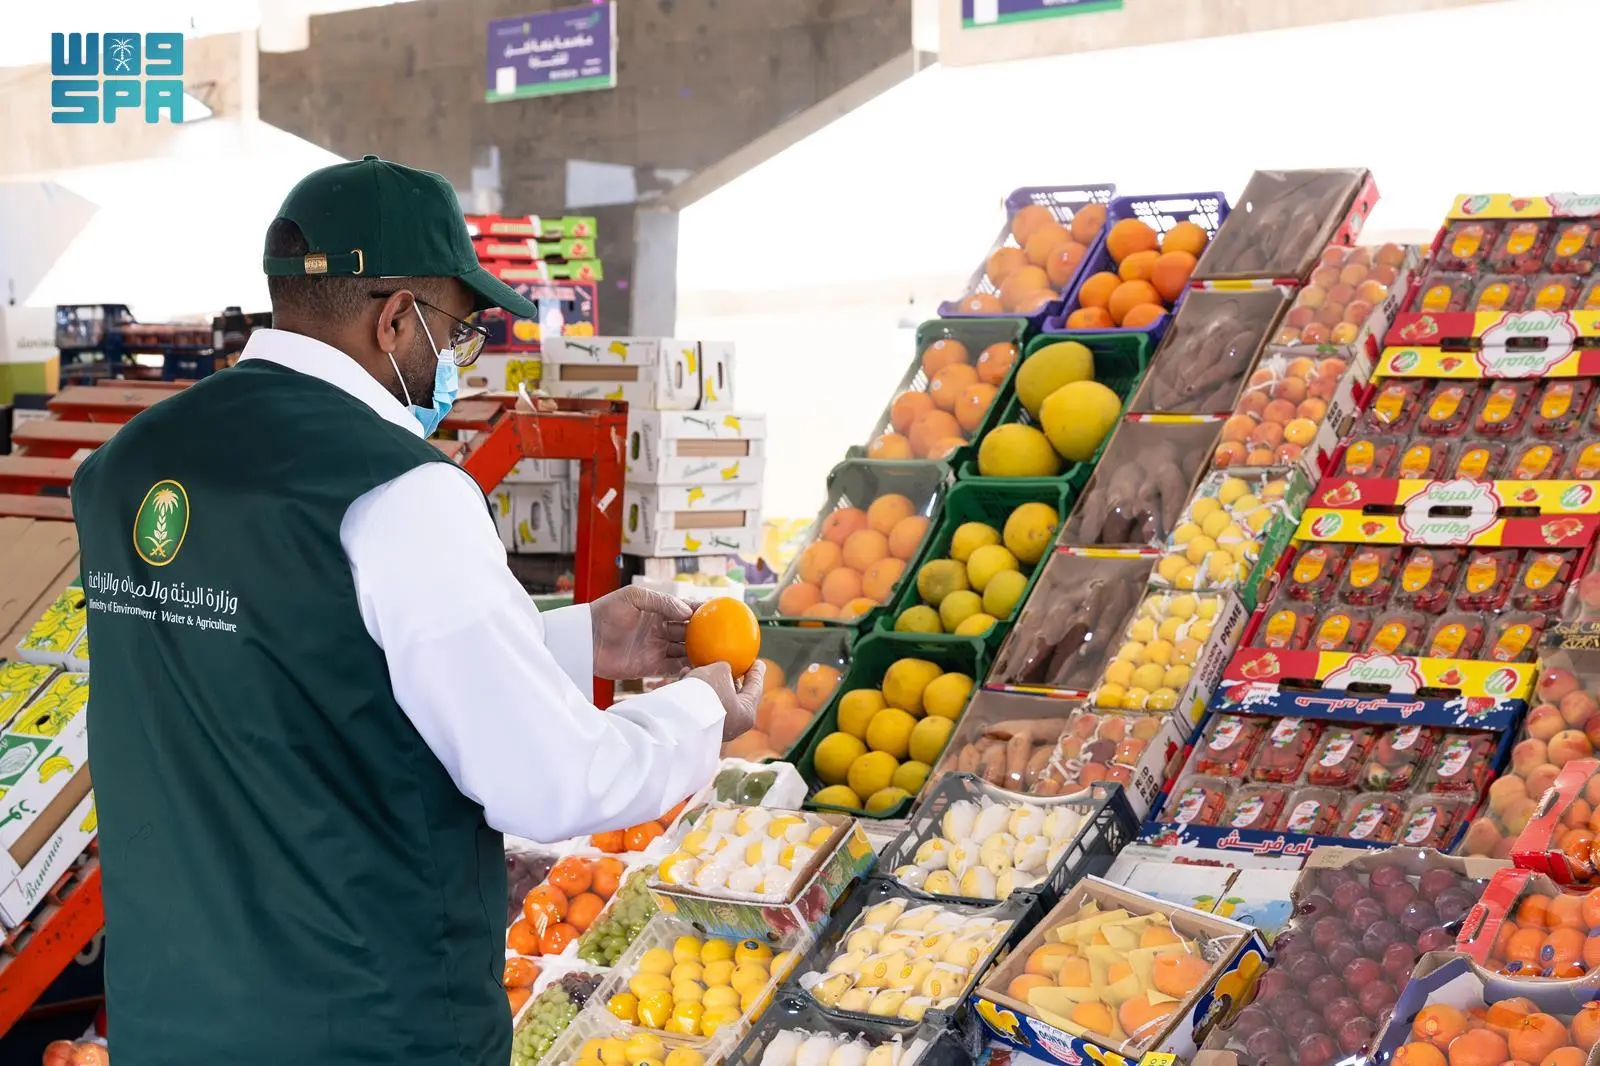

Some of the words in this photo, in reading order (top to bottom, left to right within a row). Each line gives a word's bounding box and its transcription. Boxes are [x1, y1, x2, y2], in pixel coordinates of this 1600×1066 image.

[88, 570, 119, 596] والزراعة
[121, 575, 168, 604] والمياه
[170, 582, 203, 608] البيئة
[206, 587, 238, 615] وزارة
[161, 610, 185, 624] Water
[186, 615, 194, 626] &
[195, 615, 237, 633] Agriculture
[1220, 603, 1242, 645] PRIME
[26, 835, 63, 906] Bananas
